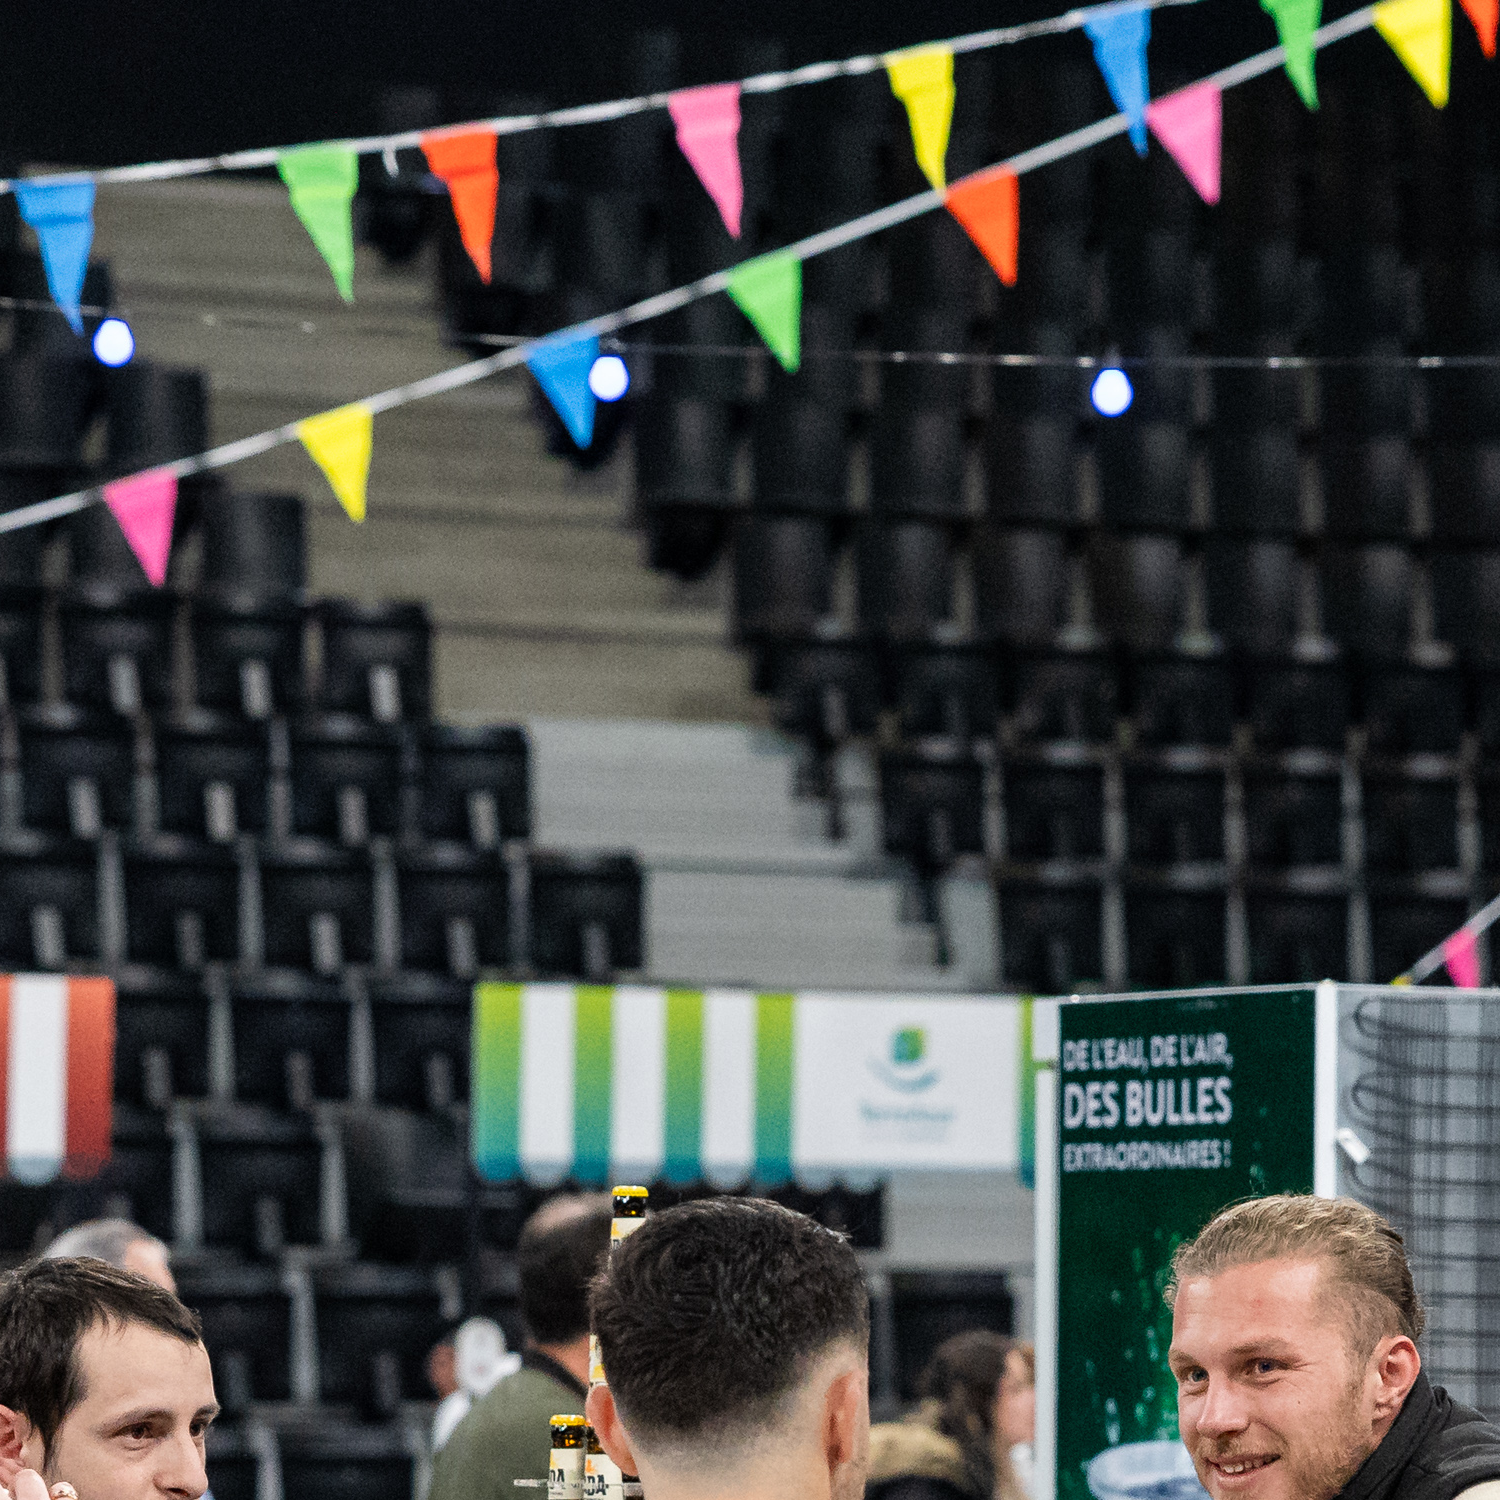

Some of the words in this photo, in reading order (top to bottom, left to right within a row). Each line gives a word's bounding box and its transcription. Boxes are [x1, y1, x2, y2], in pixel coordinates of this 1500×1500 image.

[1063, 1039, 1089, 1071] DE
[1092, 1036, 1148, 1074] L'EAU,
[1150, 1035, 1178, 1067] DE
[1180, 1032, 1234, 1071] L'AIR,
[1063, 1080, 1120, 1129] DES
[1125, 1076, 1232, 1126] BULLES
